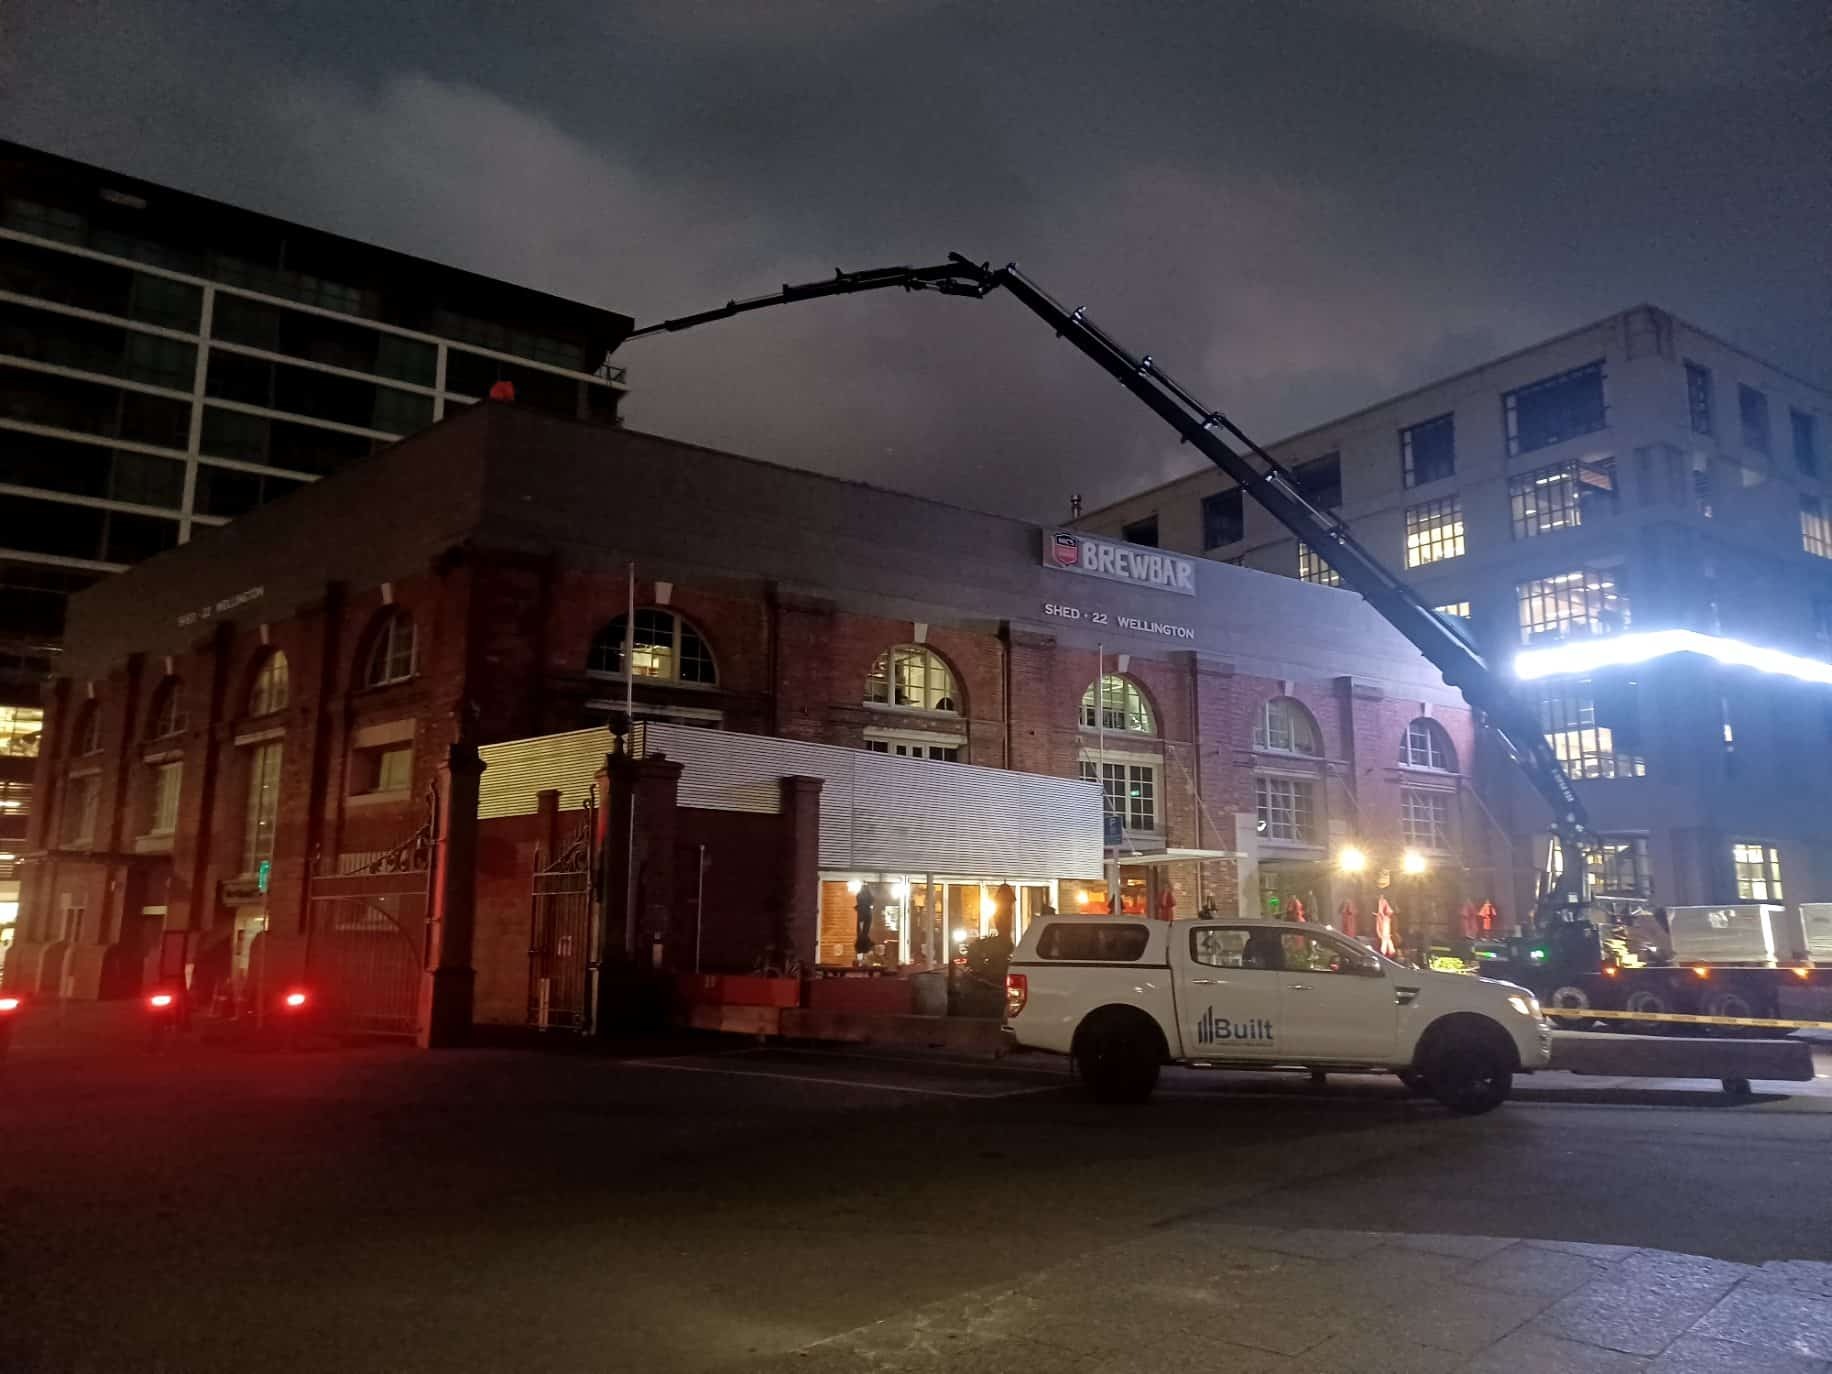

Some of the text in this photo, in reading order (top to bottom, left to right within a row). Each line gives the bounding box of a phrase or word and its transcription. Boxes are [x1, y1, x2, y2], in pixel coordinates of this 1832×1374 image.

[1082, 542, 1193, 589] BREWBAR
[1044, 603, 1195, 639] SHED 22 WELLINGTON
[1214, 1018, 1273, 1040] Built
